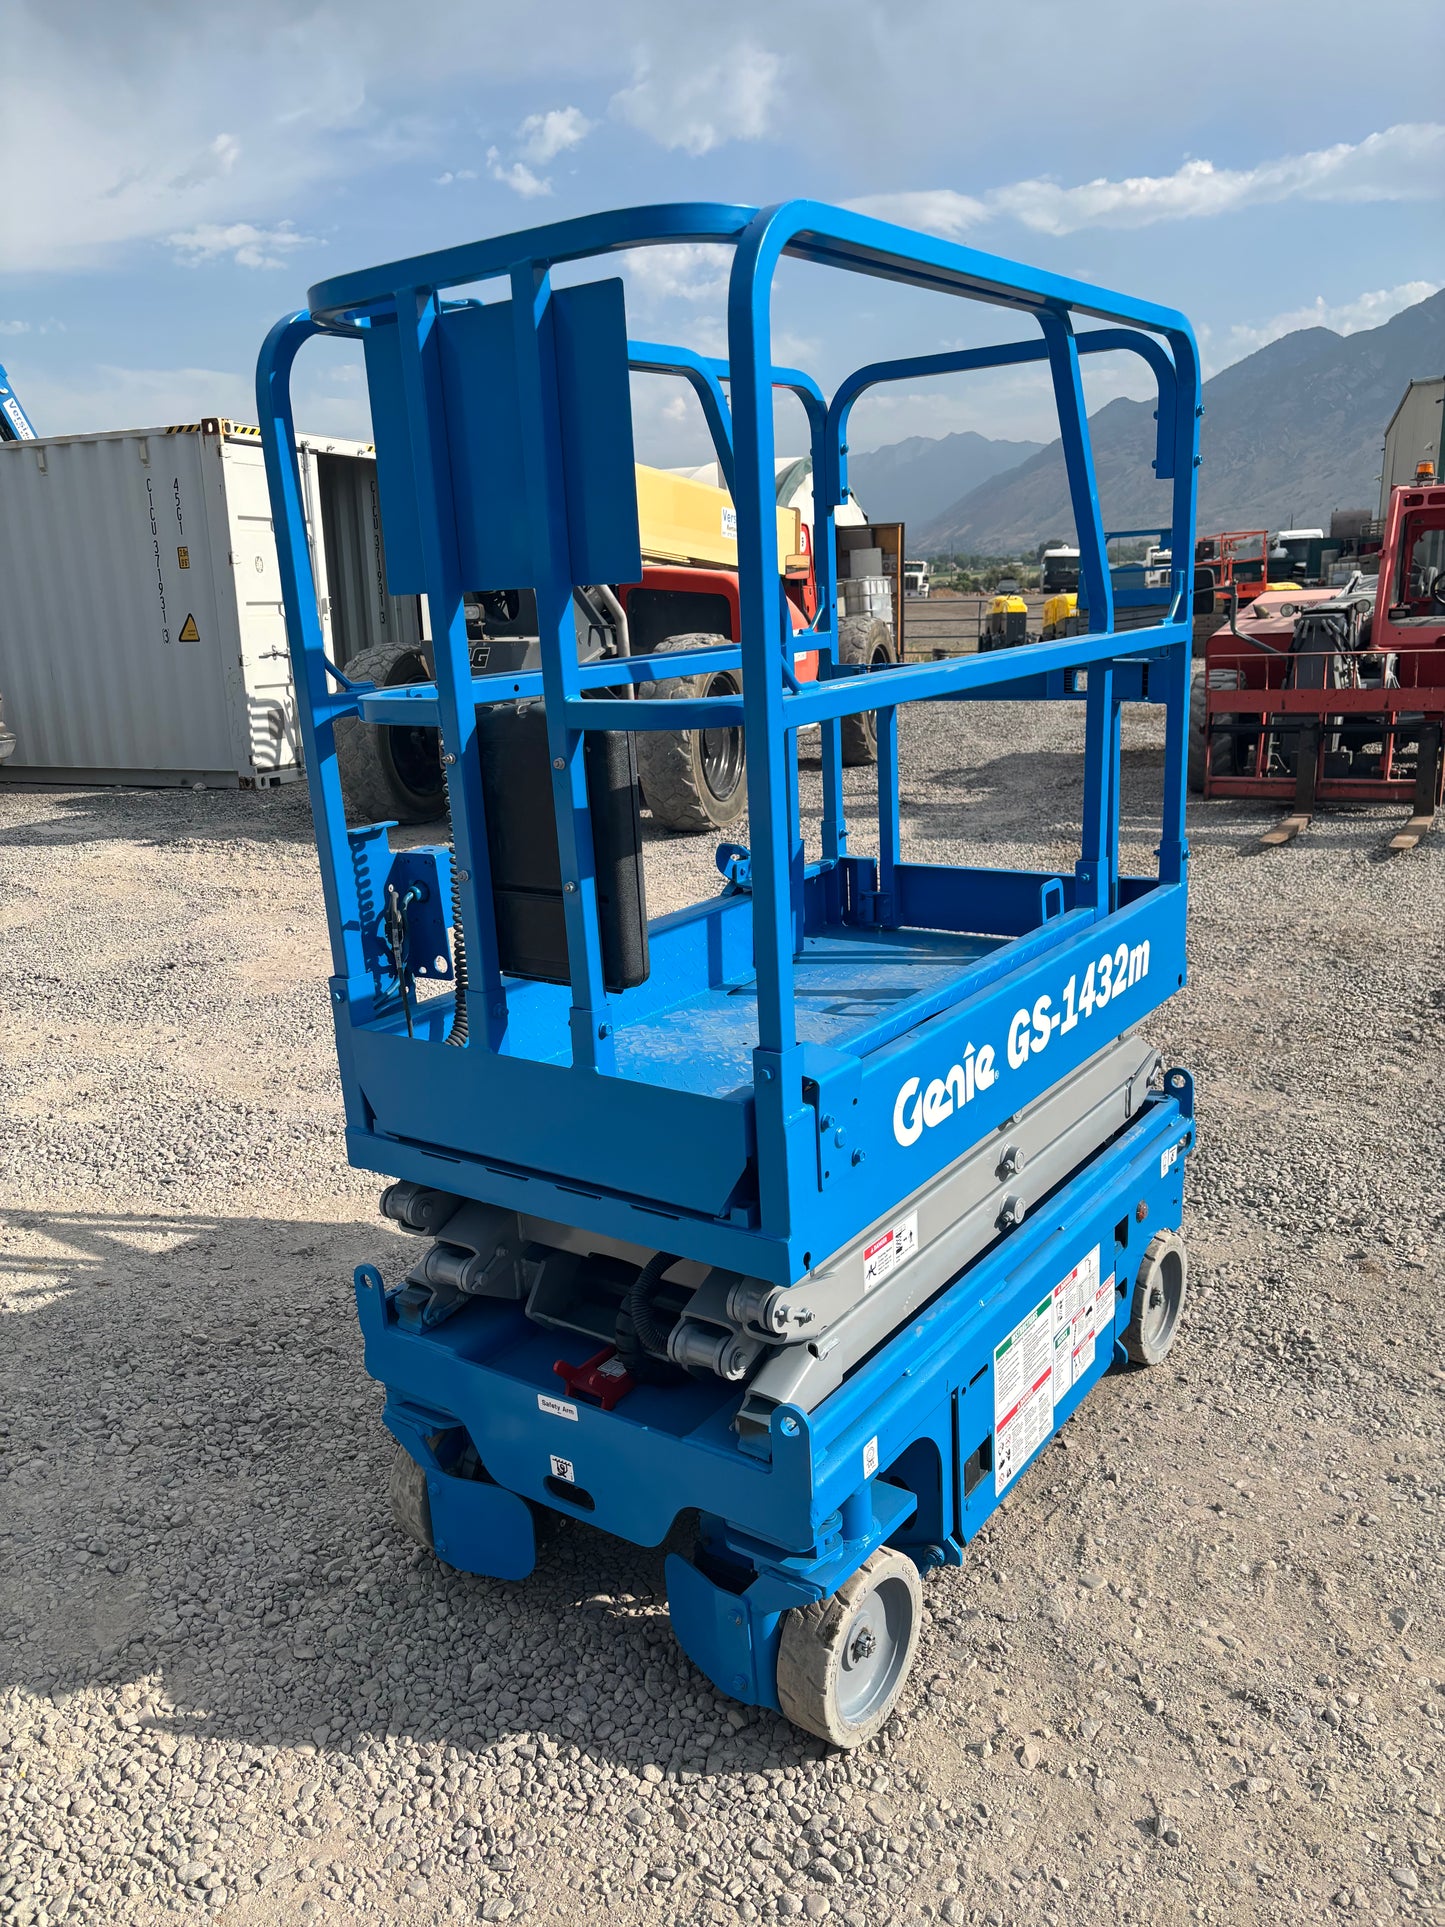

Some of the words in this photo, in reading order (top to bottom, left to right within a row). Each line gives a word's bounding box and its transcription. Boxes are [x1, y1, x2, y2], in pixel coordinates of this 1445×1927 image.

[146, 478, 157, 535] CICU
[722, 509, 737, 524] Vers
[1007, 939, 1151, 1070] GS-1432m
[541, 1399, 561, 1411] Safety
[562, 1406, 575, 1415] Arm
